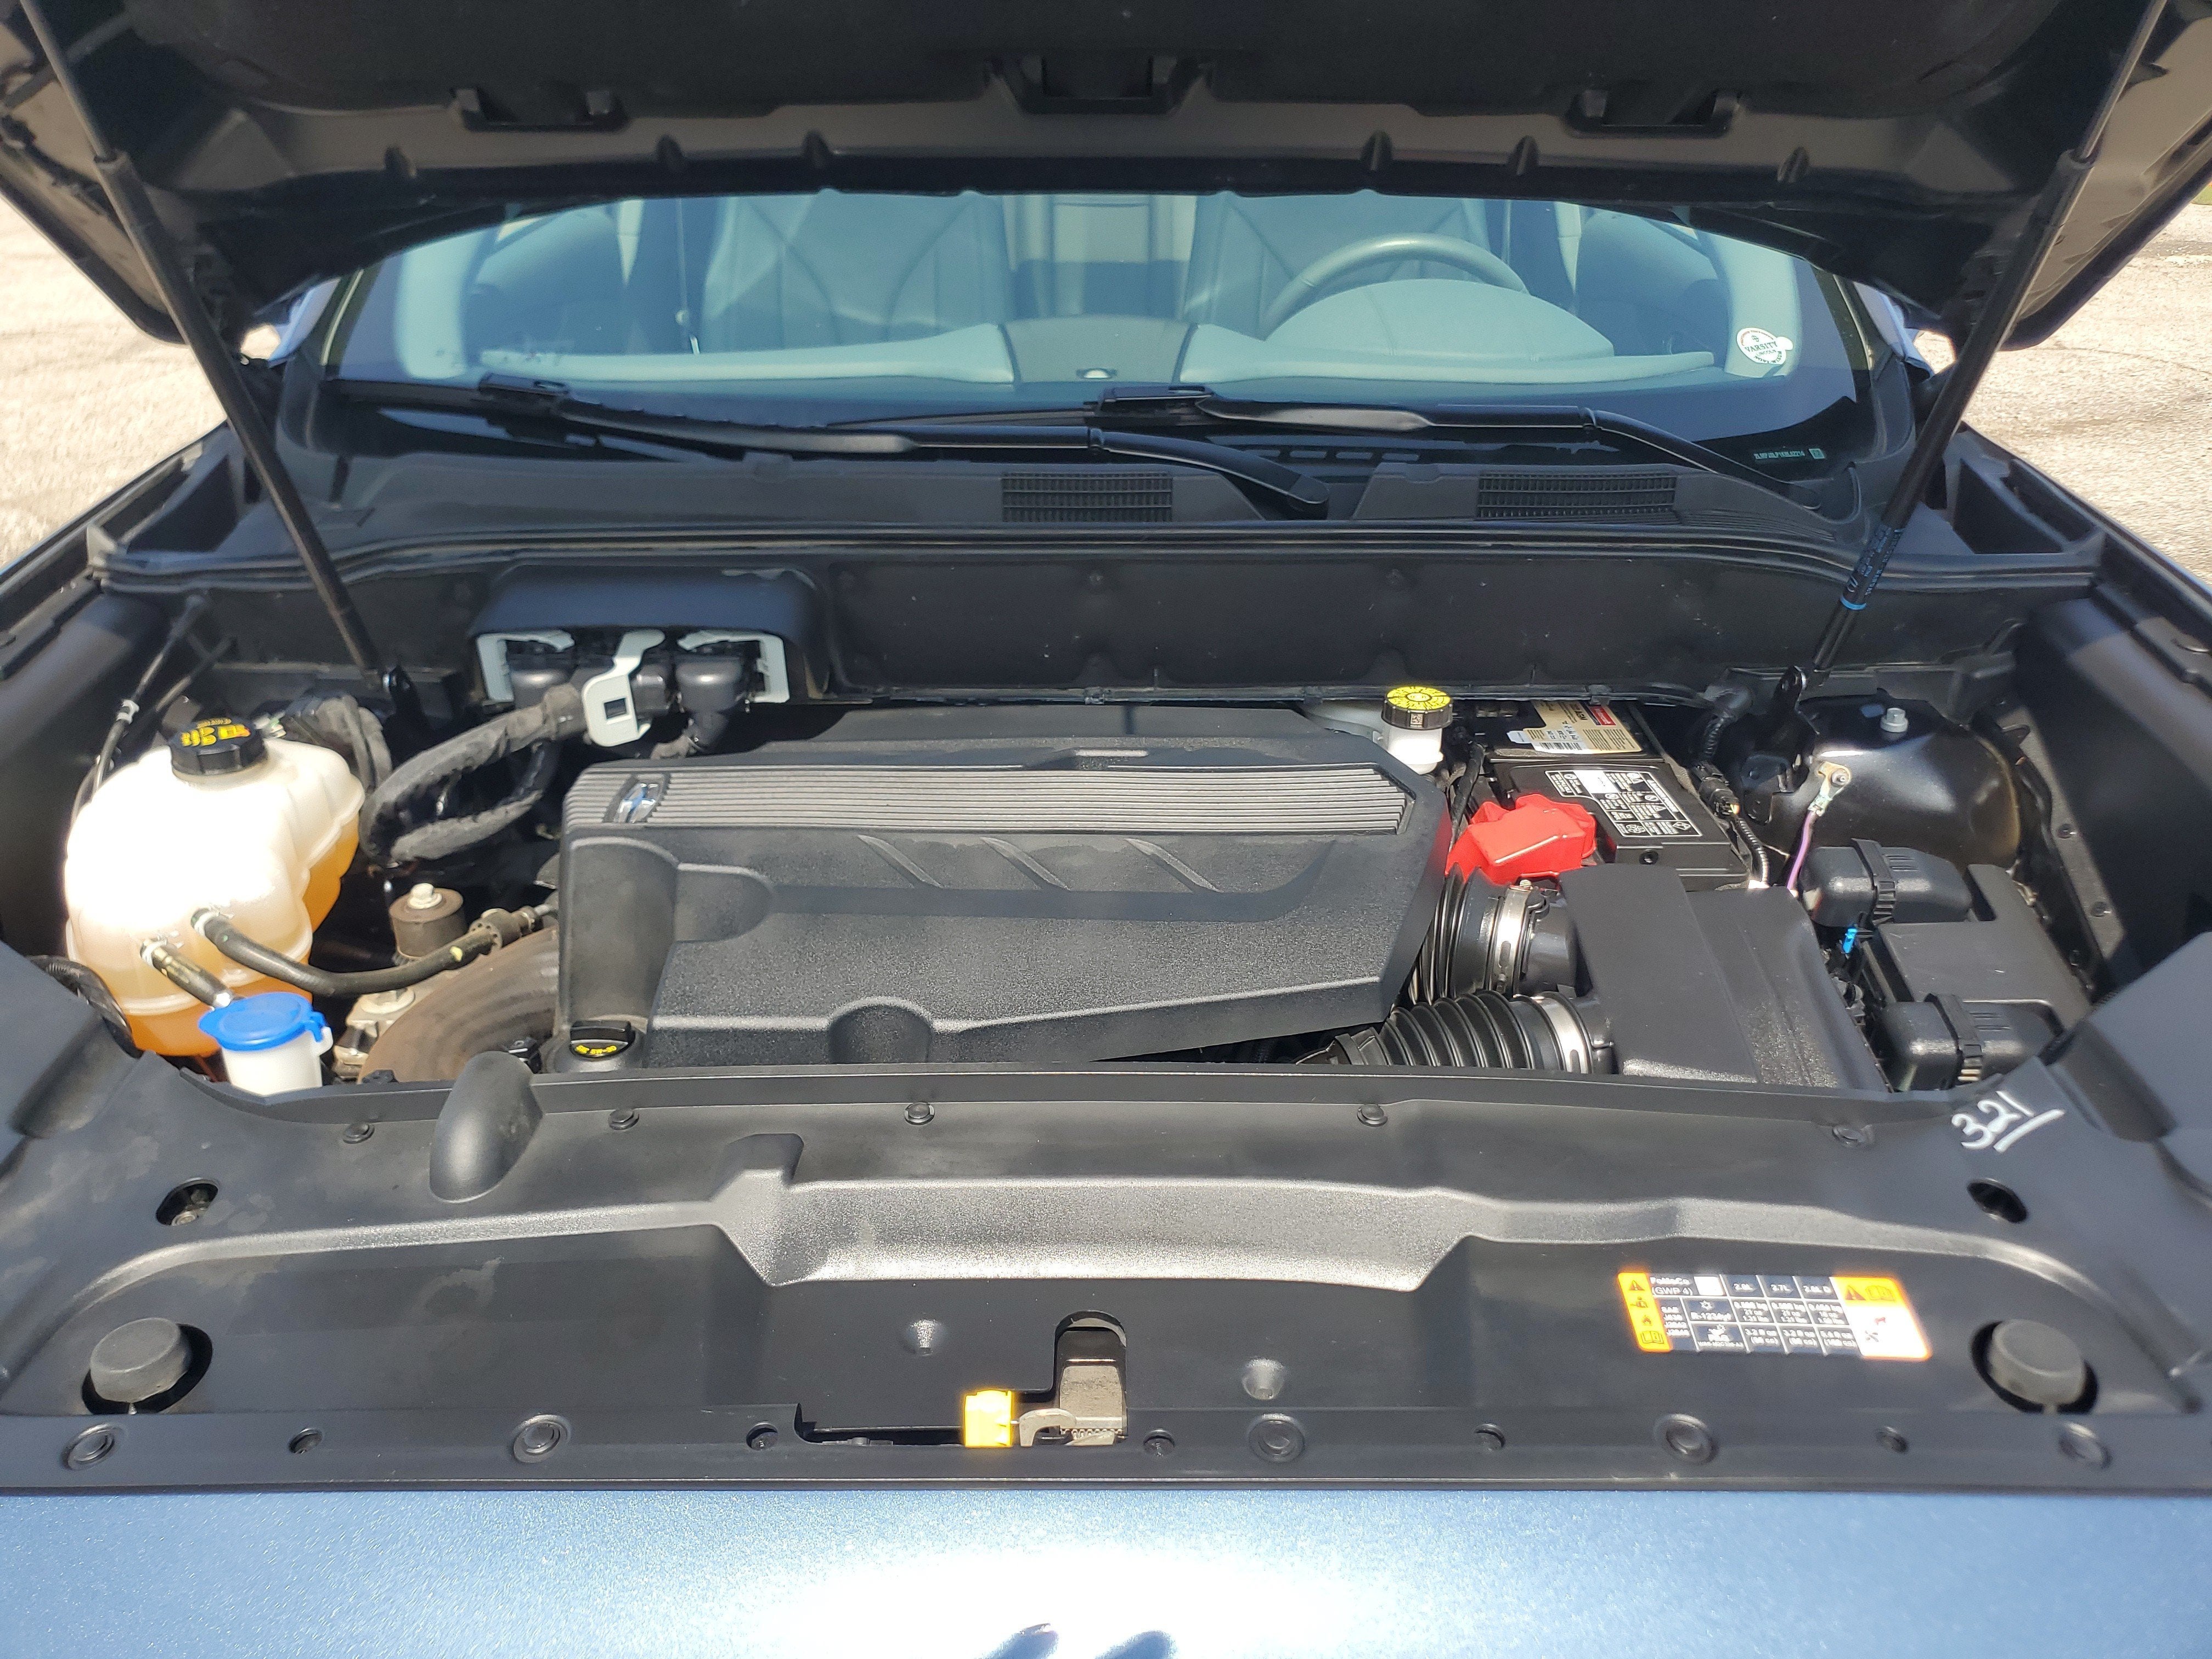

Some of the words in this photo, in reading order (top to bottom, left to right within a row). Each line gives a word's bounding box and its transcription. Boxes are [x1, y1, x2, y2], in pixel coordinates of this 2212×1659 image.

[1745, 341, 1778, 352] VARSITY
[1574, 710, 1588, 720] AGM
[1652, 1286, 1680, 1295] (GWP
[1683, 1287, 1693, 1295] 4)
[1770, 1284, 1790, 1292] 2.7L
